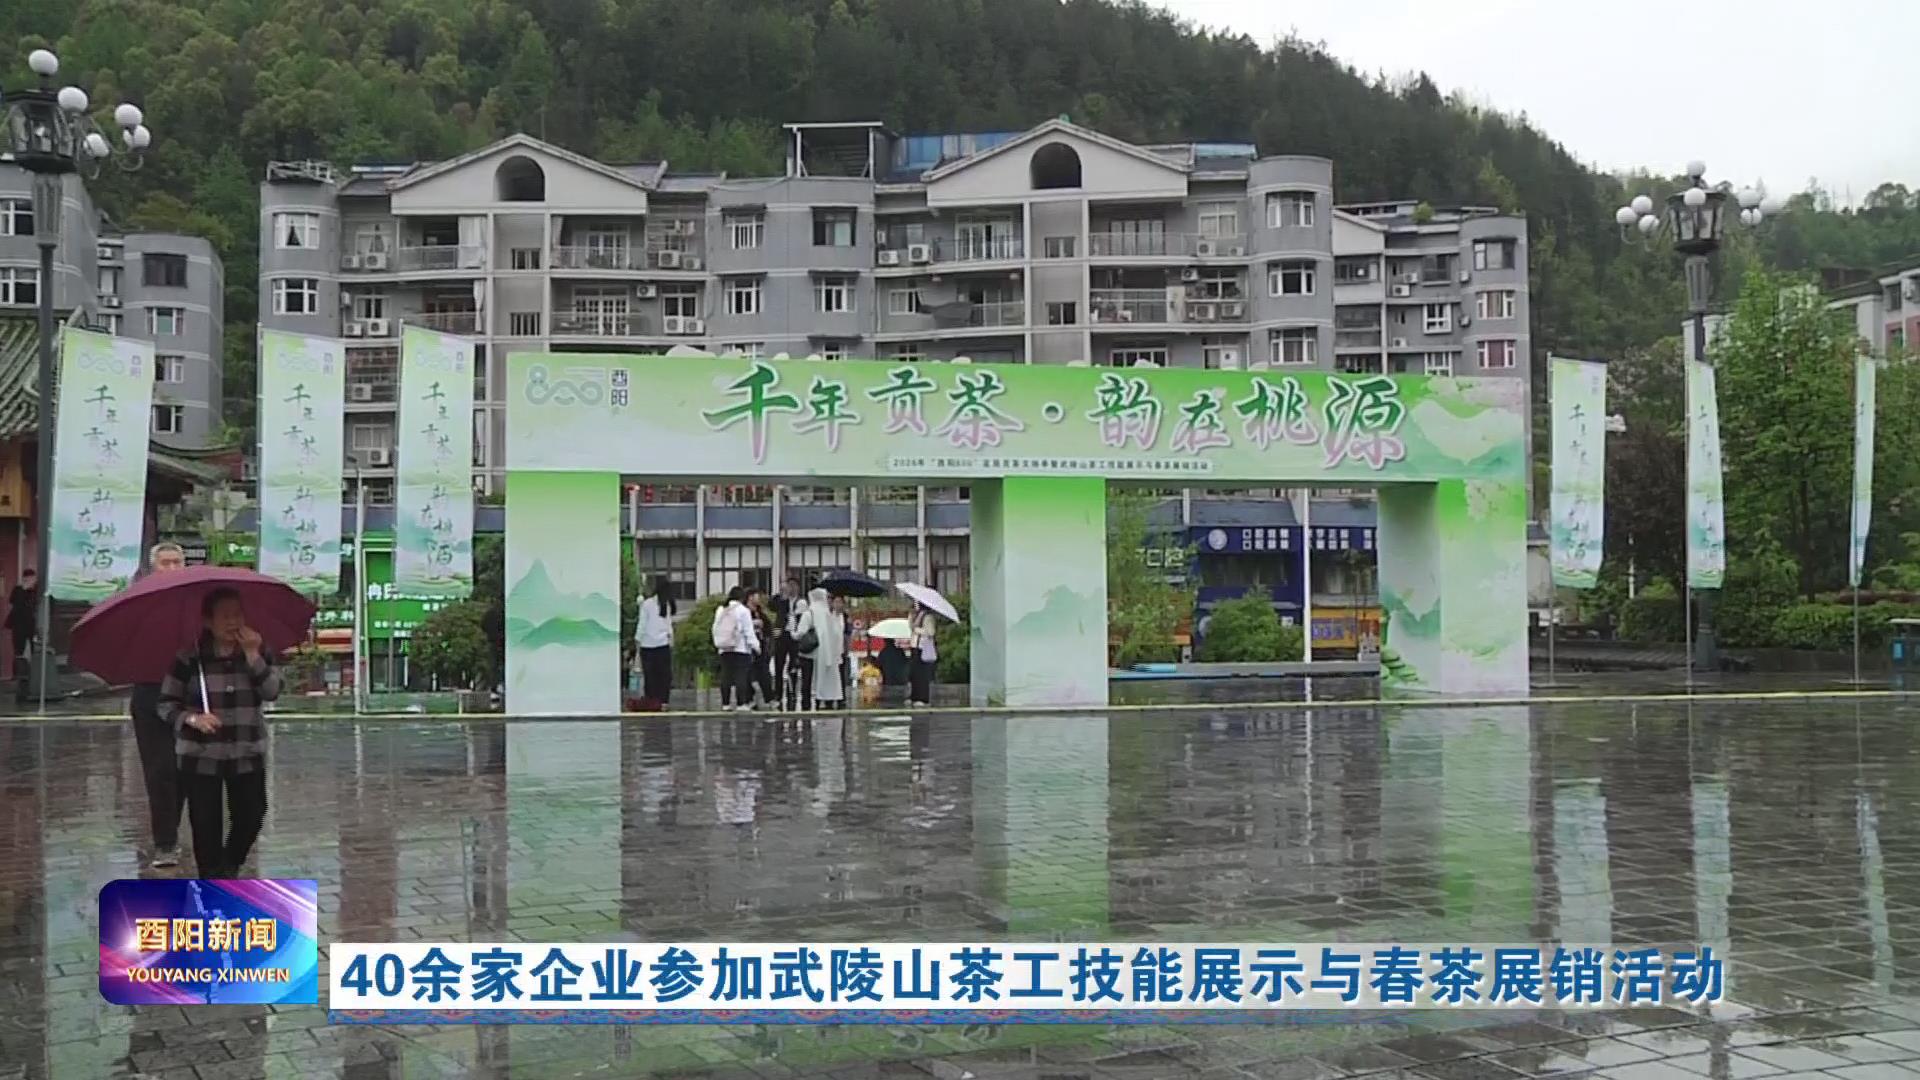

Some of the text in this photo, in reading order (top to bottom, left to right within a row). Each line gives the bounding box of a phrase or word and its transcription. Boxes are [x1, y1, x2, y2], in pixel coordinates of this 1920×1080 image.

[611, 369, 628, 406] 酉阳
[700, 362, 1408, 472] 千年贡茶·韵在桃源
